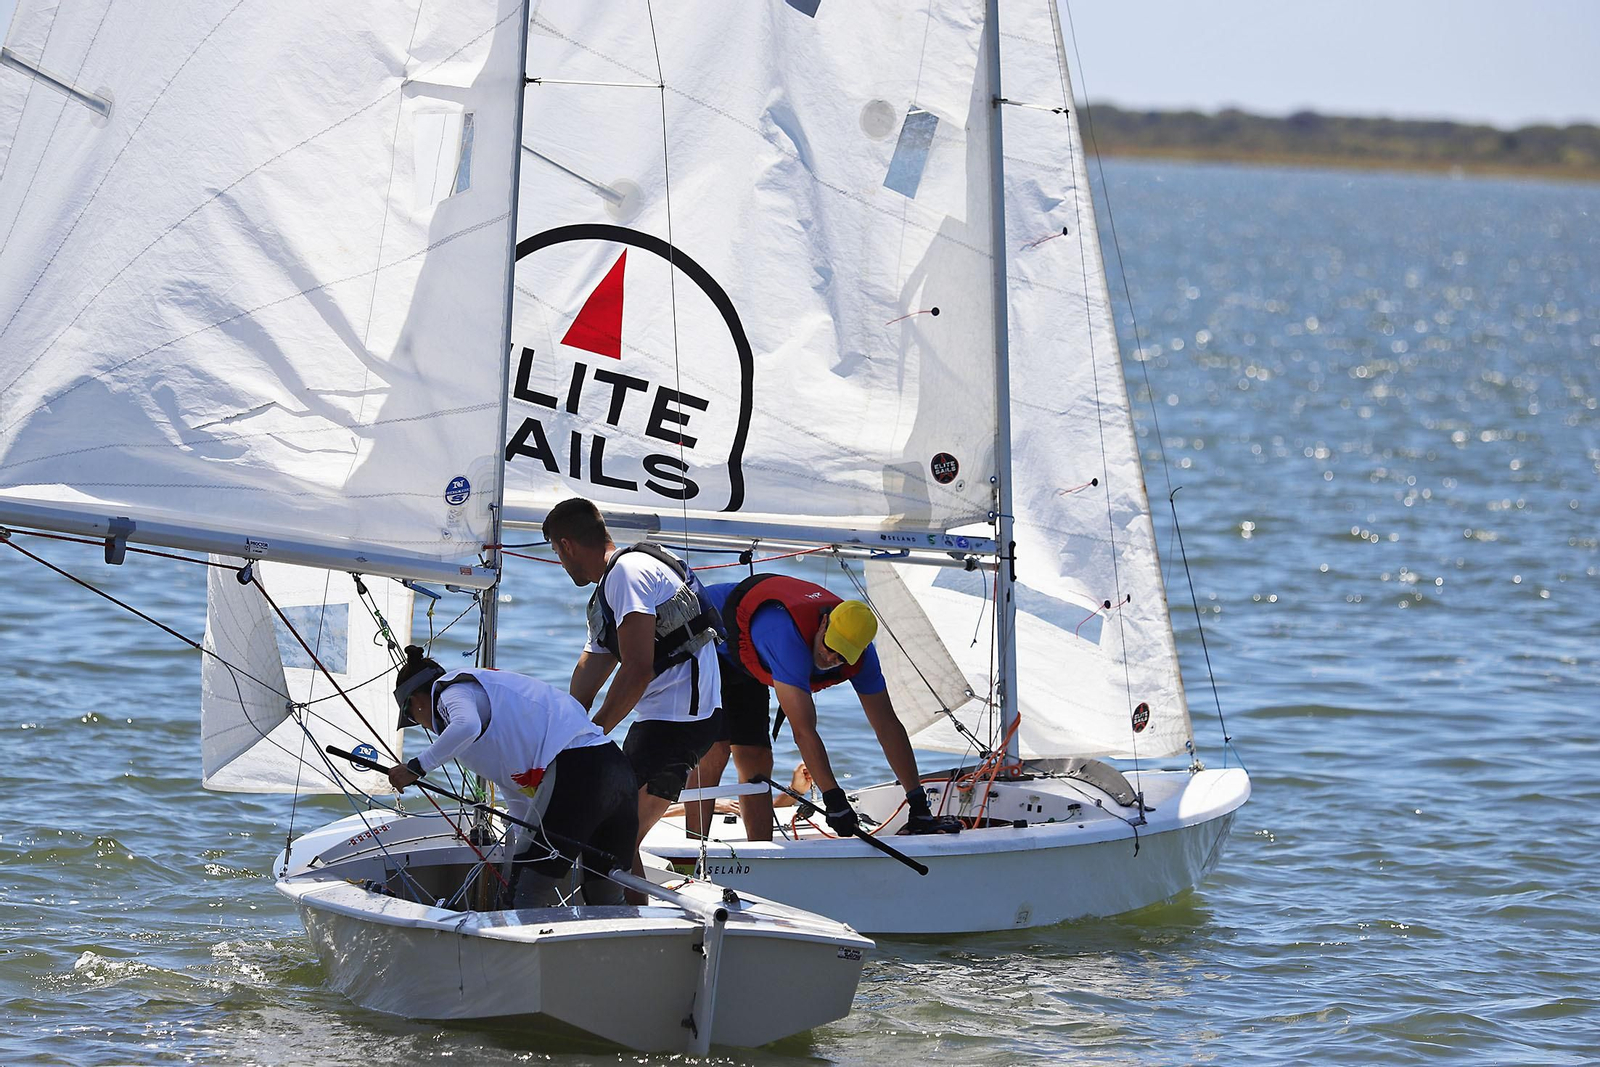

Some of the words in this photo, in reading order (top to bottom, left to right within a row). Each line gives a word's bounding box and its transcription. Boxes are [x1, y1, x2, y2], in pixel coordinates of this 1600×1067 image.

[510, 343, 710, 449] LITE
[505, 416, 700, 500] AILS
[934, 460, 956, 470] ELITE
[935, 466, 957, 475] SAILS
[887, 535, 917, 543] SELAND
[707, 866, 750, 875] SELAND
